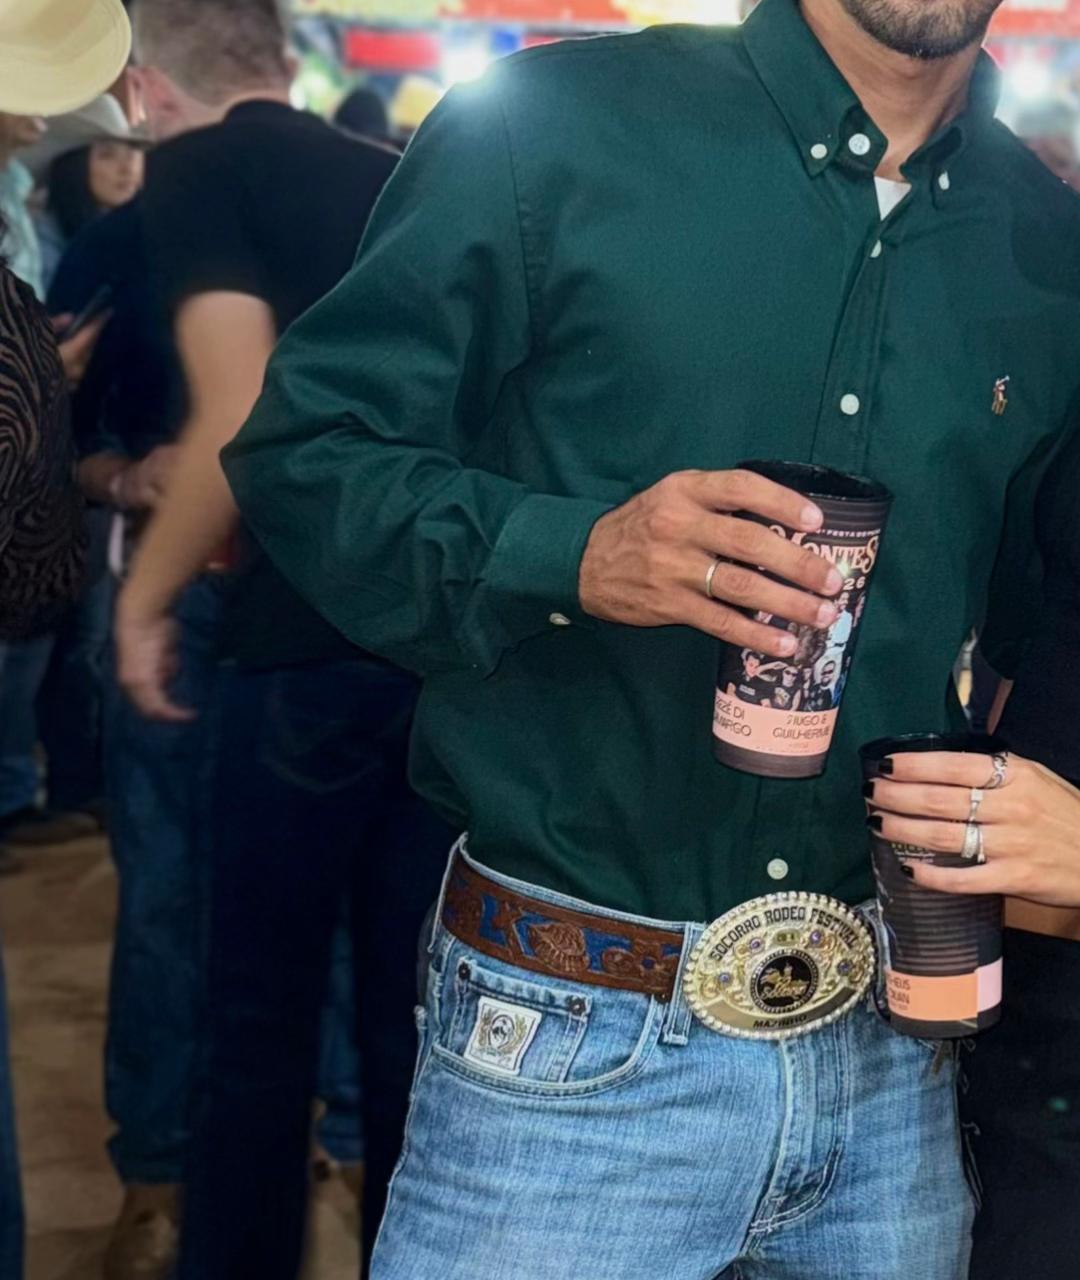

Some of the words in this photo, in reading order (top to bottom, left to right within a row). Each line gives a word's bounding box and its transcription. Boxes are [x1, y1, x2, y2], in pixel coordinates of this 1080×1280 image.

[733, 706, 745, 720] DI
[710, 915, 761, 961] SOCORRO
[764, 906, 806, 924] RODEO
[809, 908, 859, 950] FESTIVAL
